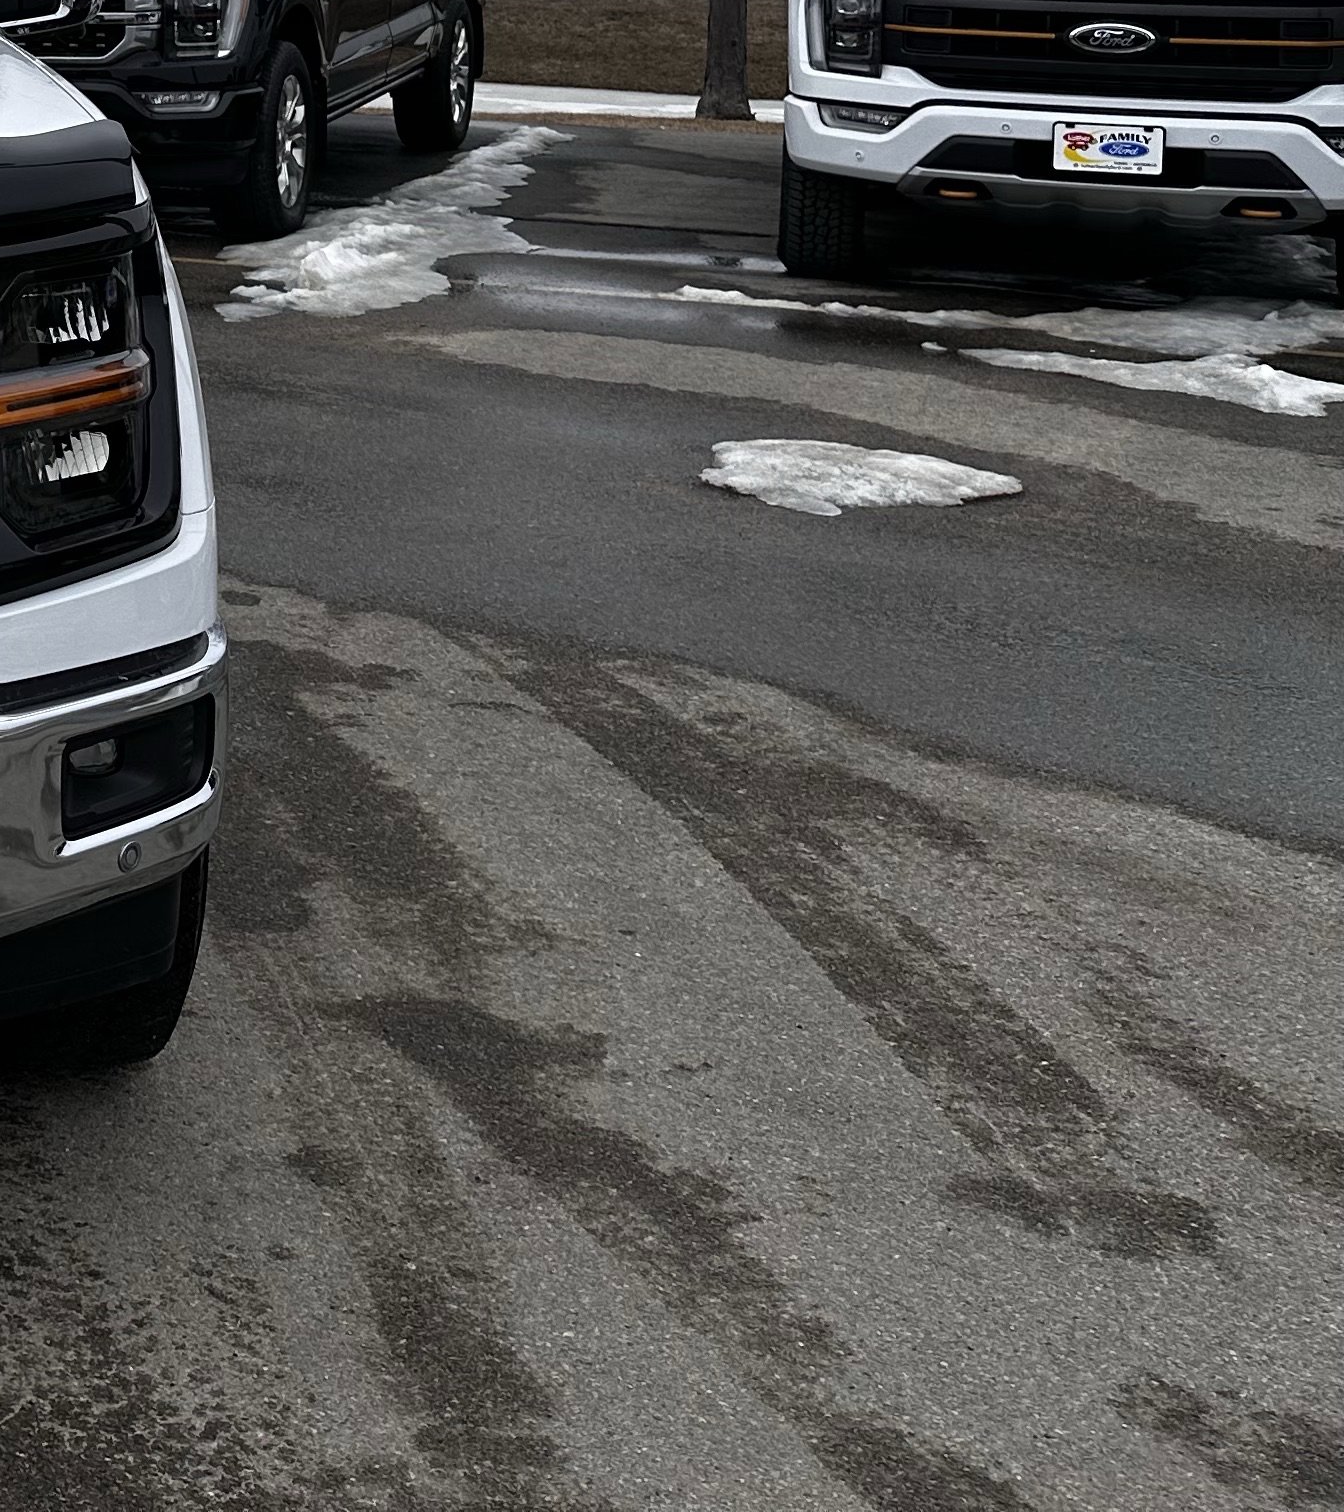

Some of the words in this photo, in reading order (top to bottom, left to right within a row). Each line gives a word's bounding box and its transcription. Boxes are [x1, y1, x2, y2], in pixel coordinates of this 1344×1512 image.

[1089, 29, 1136, 47] Ford
[1099, 132, 1153, 145] FAMILY
[1108, 143, 1140, 155] Ford
